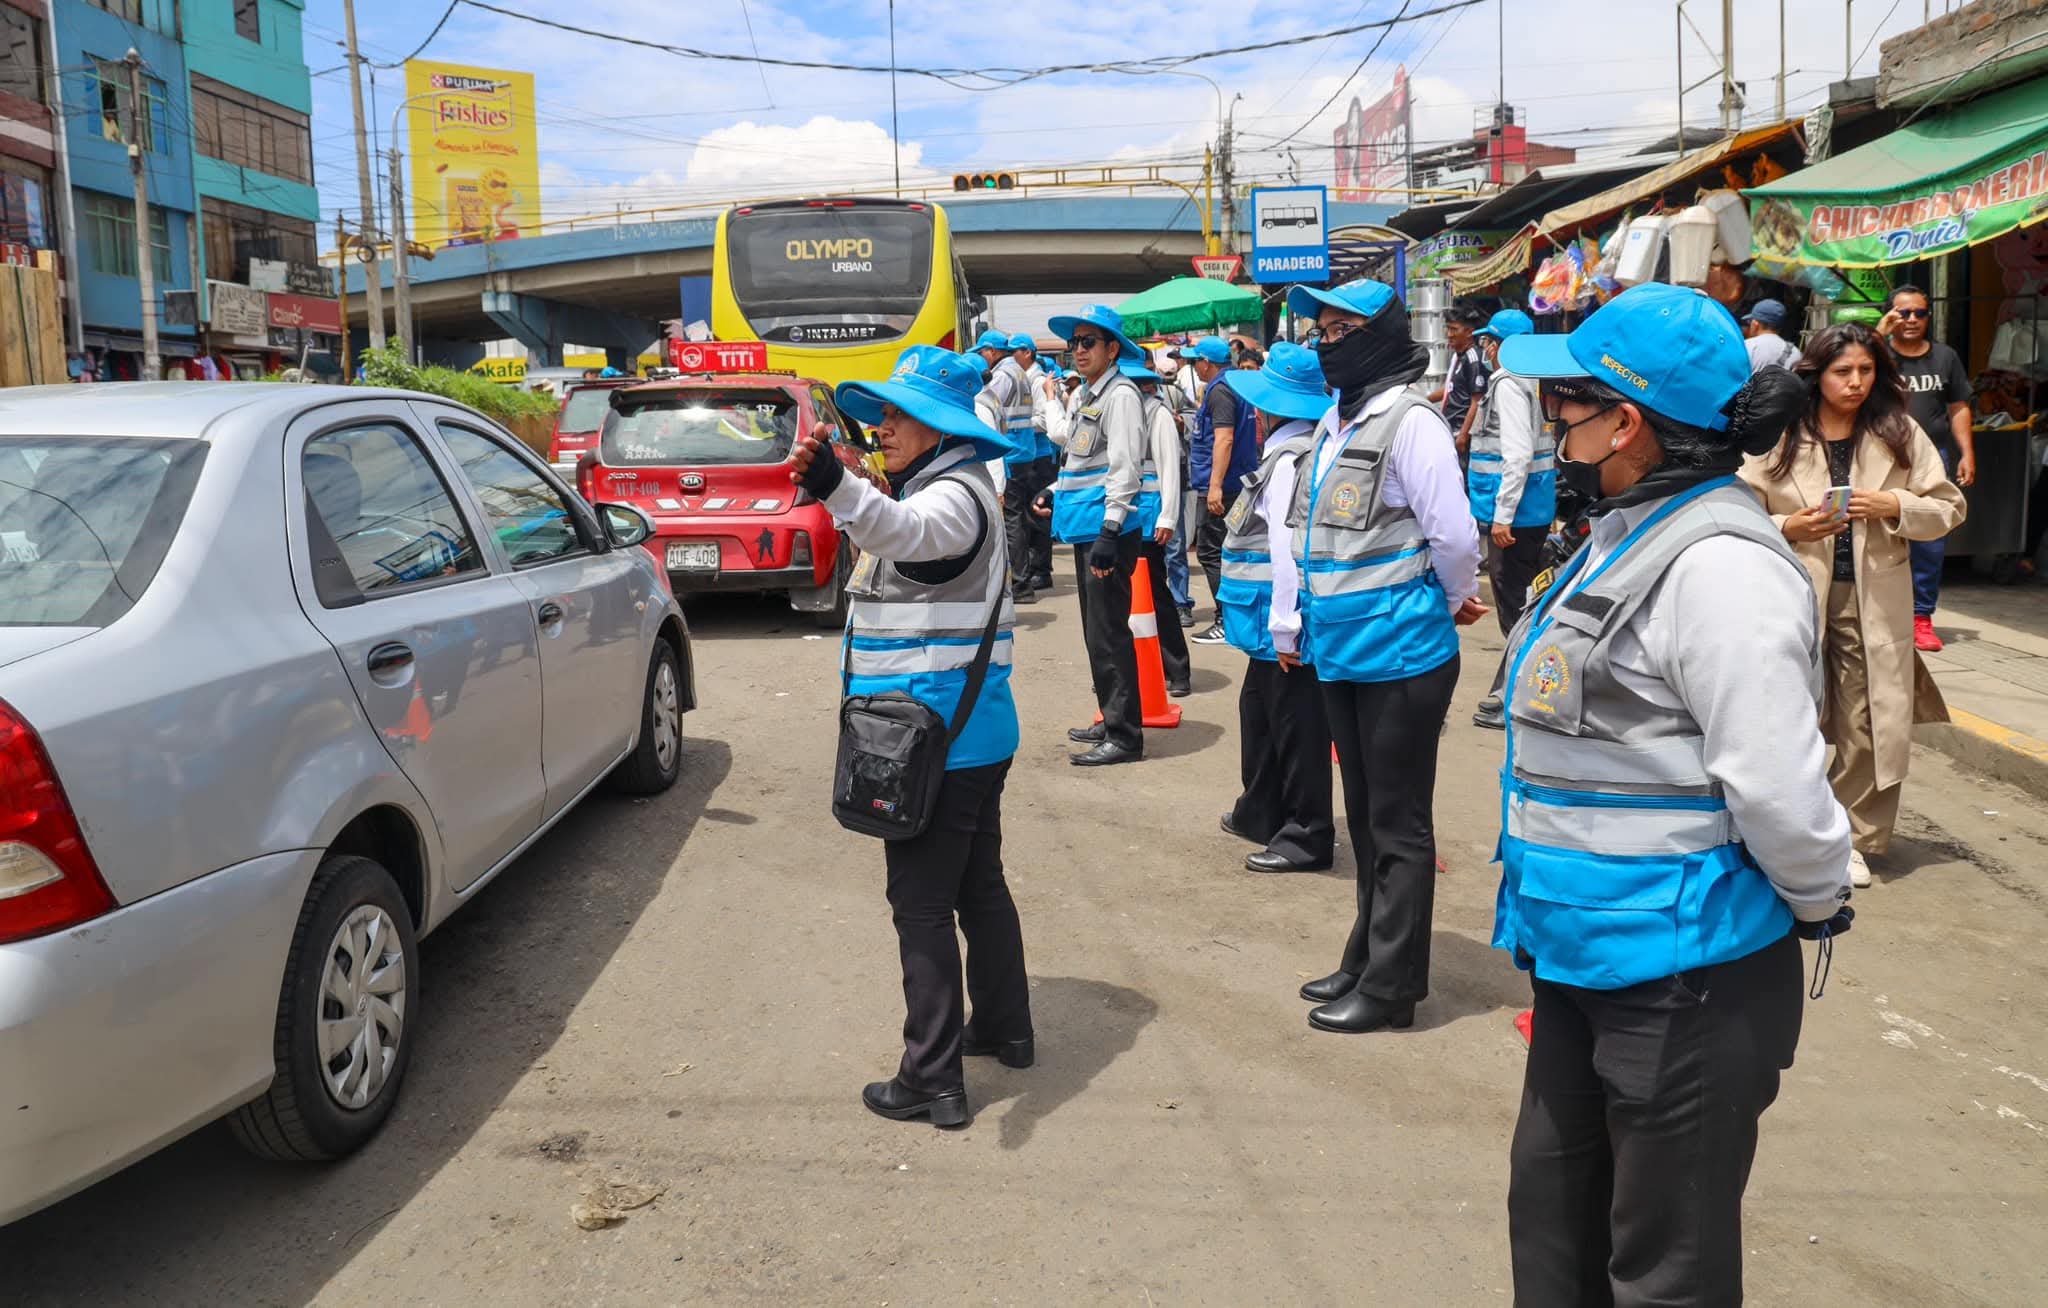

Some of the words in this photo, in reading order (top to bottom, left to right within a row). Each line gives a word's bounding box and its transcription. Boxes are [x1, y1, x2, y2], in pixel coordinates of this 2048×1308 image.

[439, 100, 508, 126] Friskies
[1808, 151, 2048, 246] CHICHARRONERI
[786, 238, 873, 261] OLYMPO
[832, 261, 872, 273] URBANO
[1257, 255, 1324, 272] PARADERO
[272, 306, 304, 325] Claro
[806, 327, 877, 340] INTRAMET
[1600, 353, 1649, 390] INSPECTOR
[757, 404, 776, 414] 137
[615, 481, 660, 496] AUF-408
[682, 475, 699, 486] KIA
[668, 549, 717, 565] AUF-408
